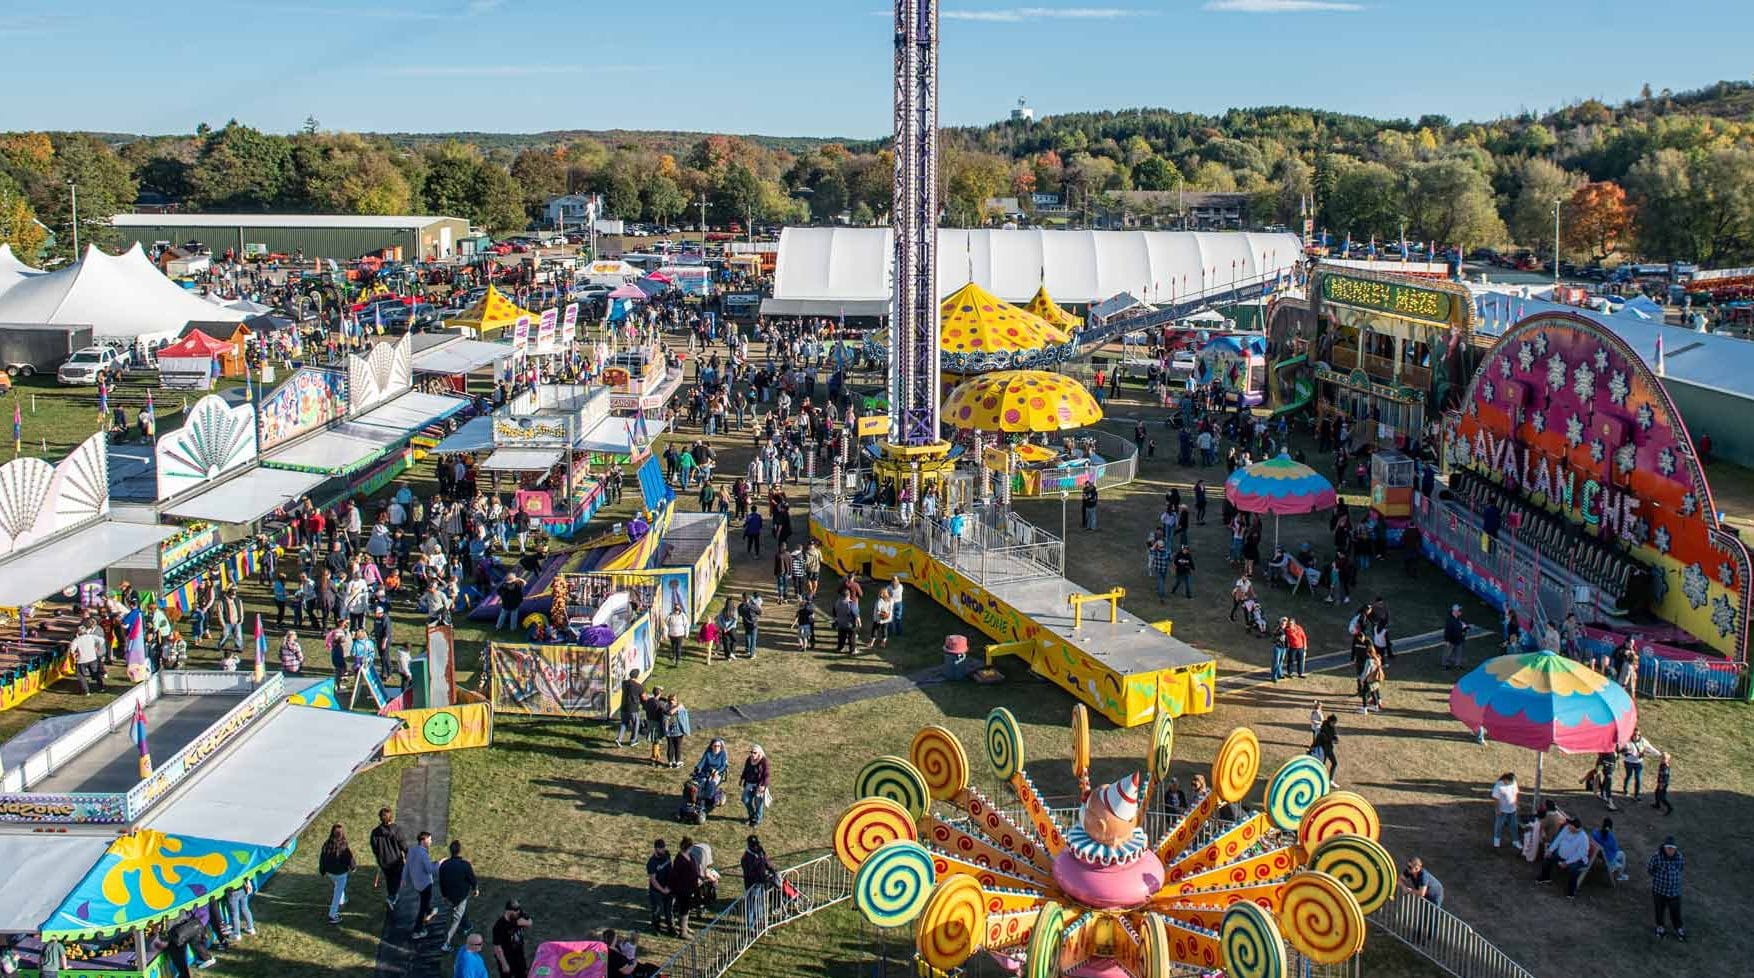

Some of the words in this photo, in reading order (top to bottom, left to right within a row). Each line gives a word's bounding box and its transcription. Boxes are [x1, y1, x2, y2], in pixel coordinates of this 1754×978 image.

[1330, 277, 1390, 307] MONKEY
[1394, 286, 1438, 315] MAZE
[1473, 428, 1641, 546] AVALANCHE
[960, 591, 985, 614] DROP
[983, 608, 1008, 634] ZONE
